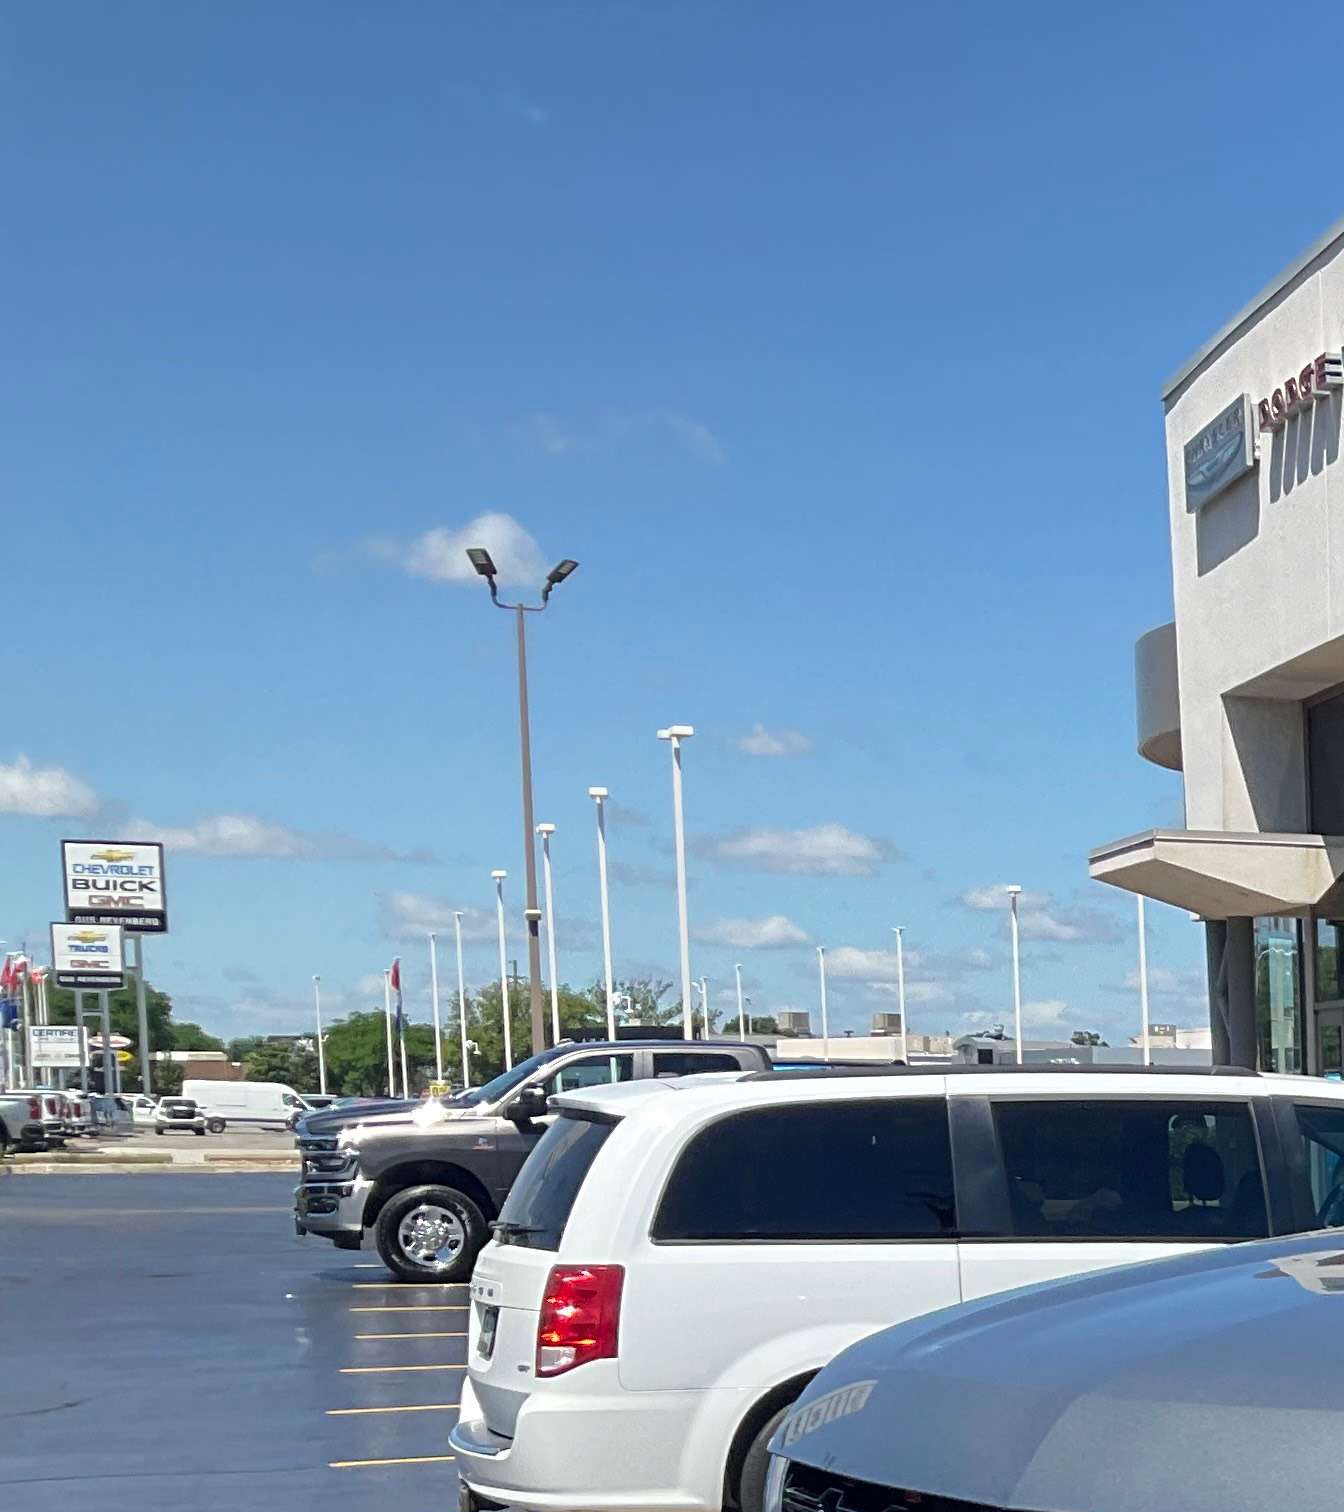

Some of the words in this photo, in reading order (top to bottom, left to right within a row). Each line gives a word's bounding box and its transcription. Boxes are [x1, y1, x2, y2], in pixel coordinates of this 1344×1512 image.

[1259, 353, 1343, 430] DODGE
[72, 863, 155, 876] CHEVROLET
[71, 878, 157, 892] BUICK
[87, 895, 144, 908] GMC
[68, 944, 109, 954] TRUCKS
[69, 959, 110, 969] GMC
